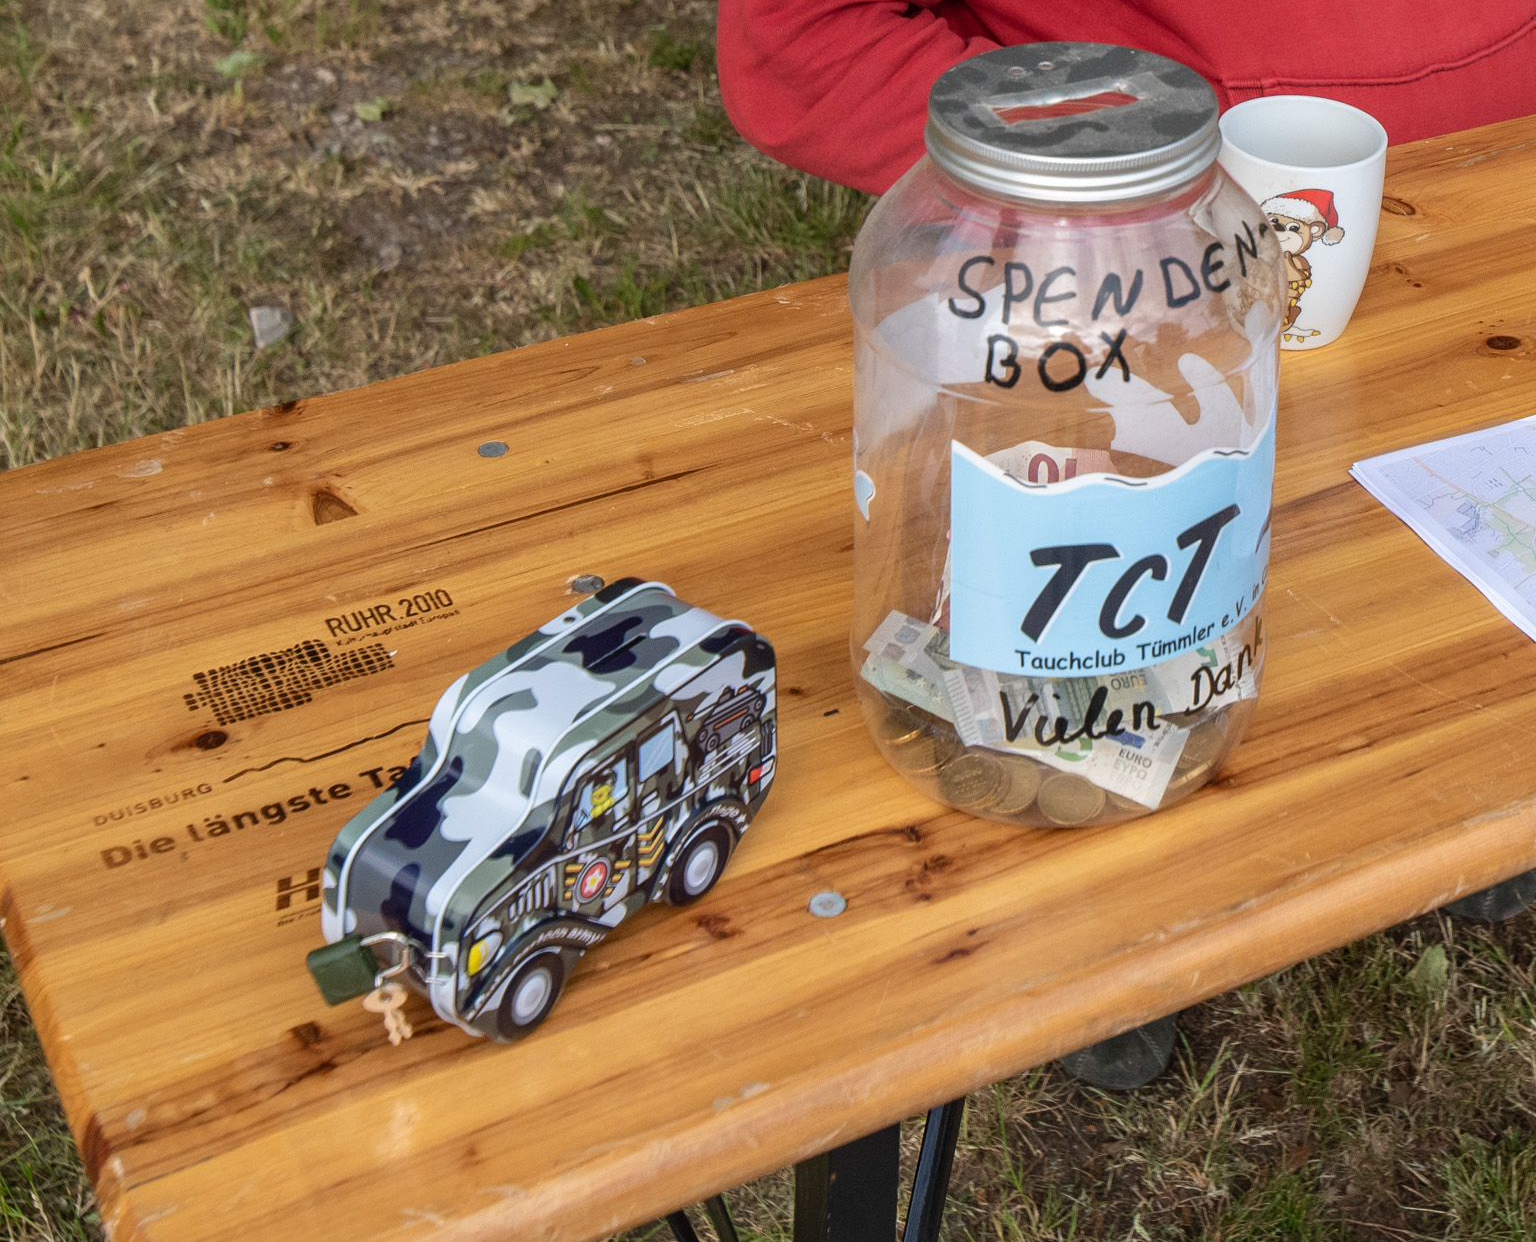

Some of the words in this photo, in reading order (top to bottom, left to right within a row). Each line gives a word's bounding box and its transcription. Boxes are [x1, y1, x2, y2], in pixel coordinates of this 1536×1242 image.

[985, 329, 1130, 392] BOX
[1020, 503, 1242, 644] TCT
[325, 588, 453, 637] RUHR.2010
[1014, 649, 1126, 671] Tauchclub
[1136, 622, 1215, 661] Tümmler
[1000, 685, 1161, 746] Vielen
[1184, 615, 1263, 716] Dank
[1118, 748, 1152, 769] EURO
[93, 782, 213, 827] DUISBURG
[100, 835, 176, 870] Die
[186, 781, 354, 843] längste
[358, 763, 413, 791] Ta
[276, 867, 321, 911] H
